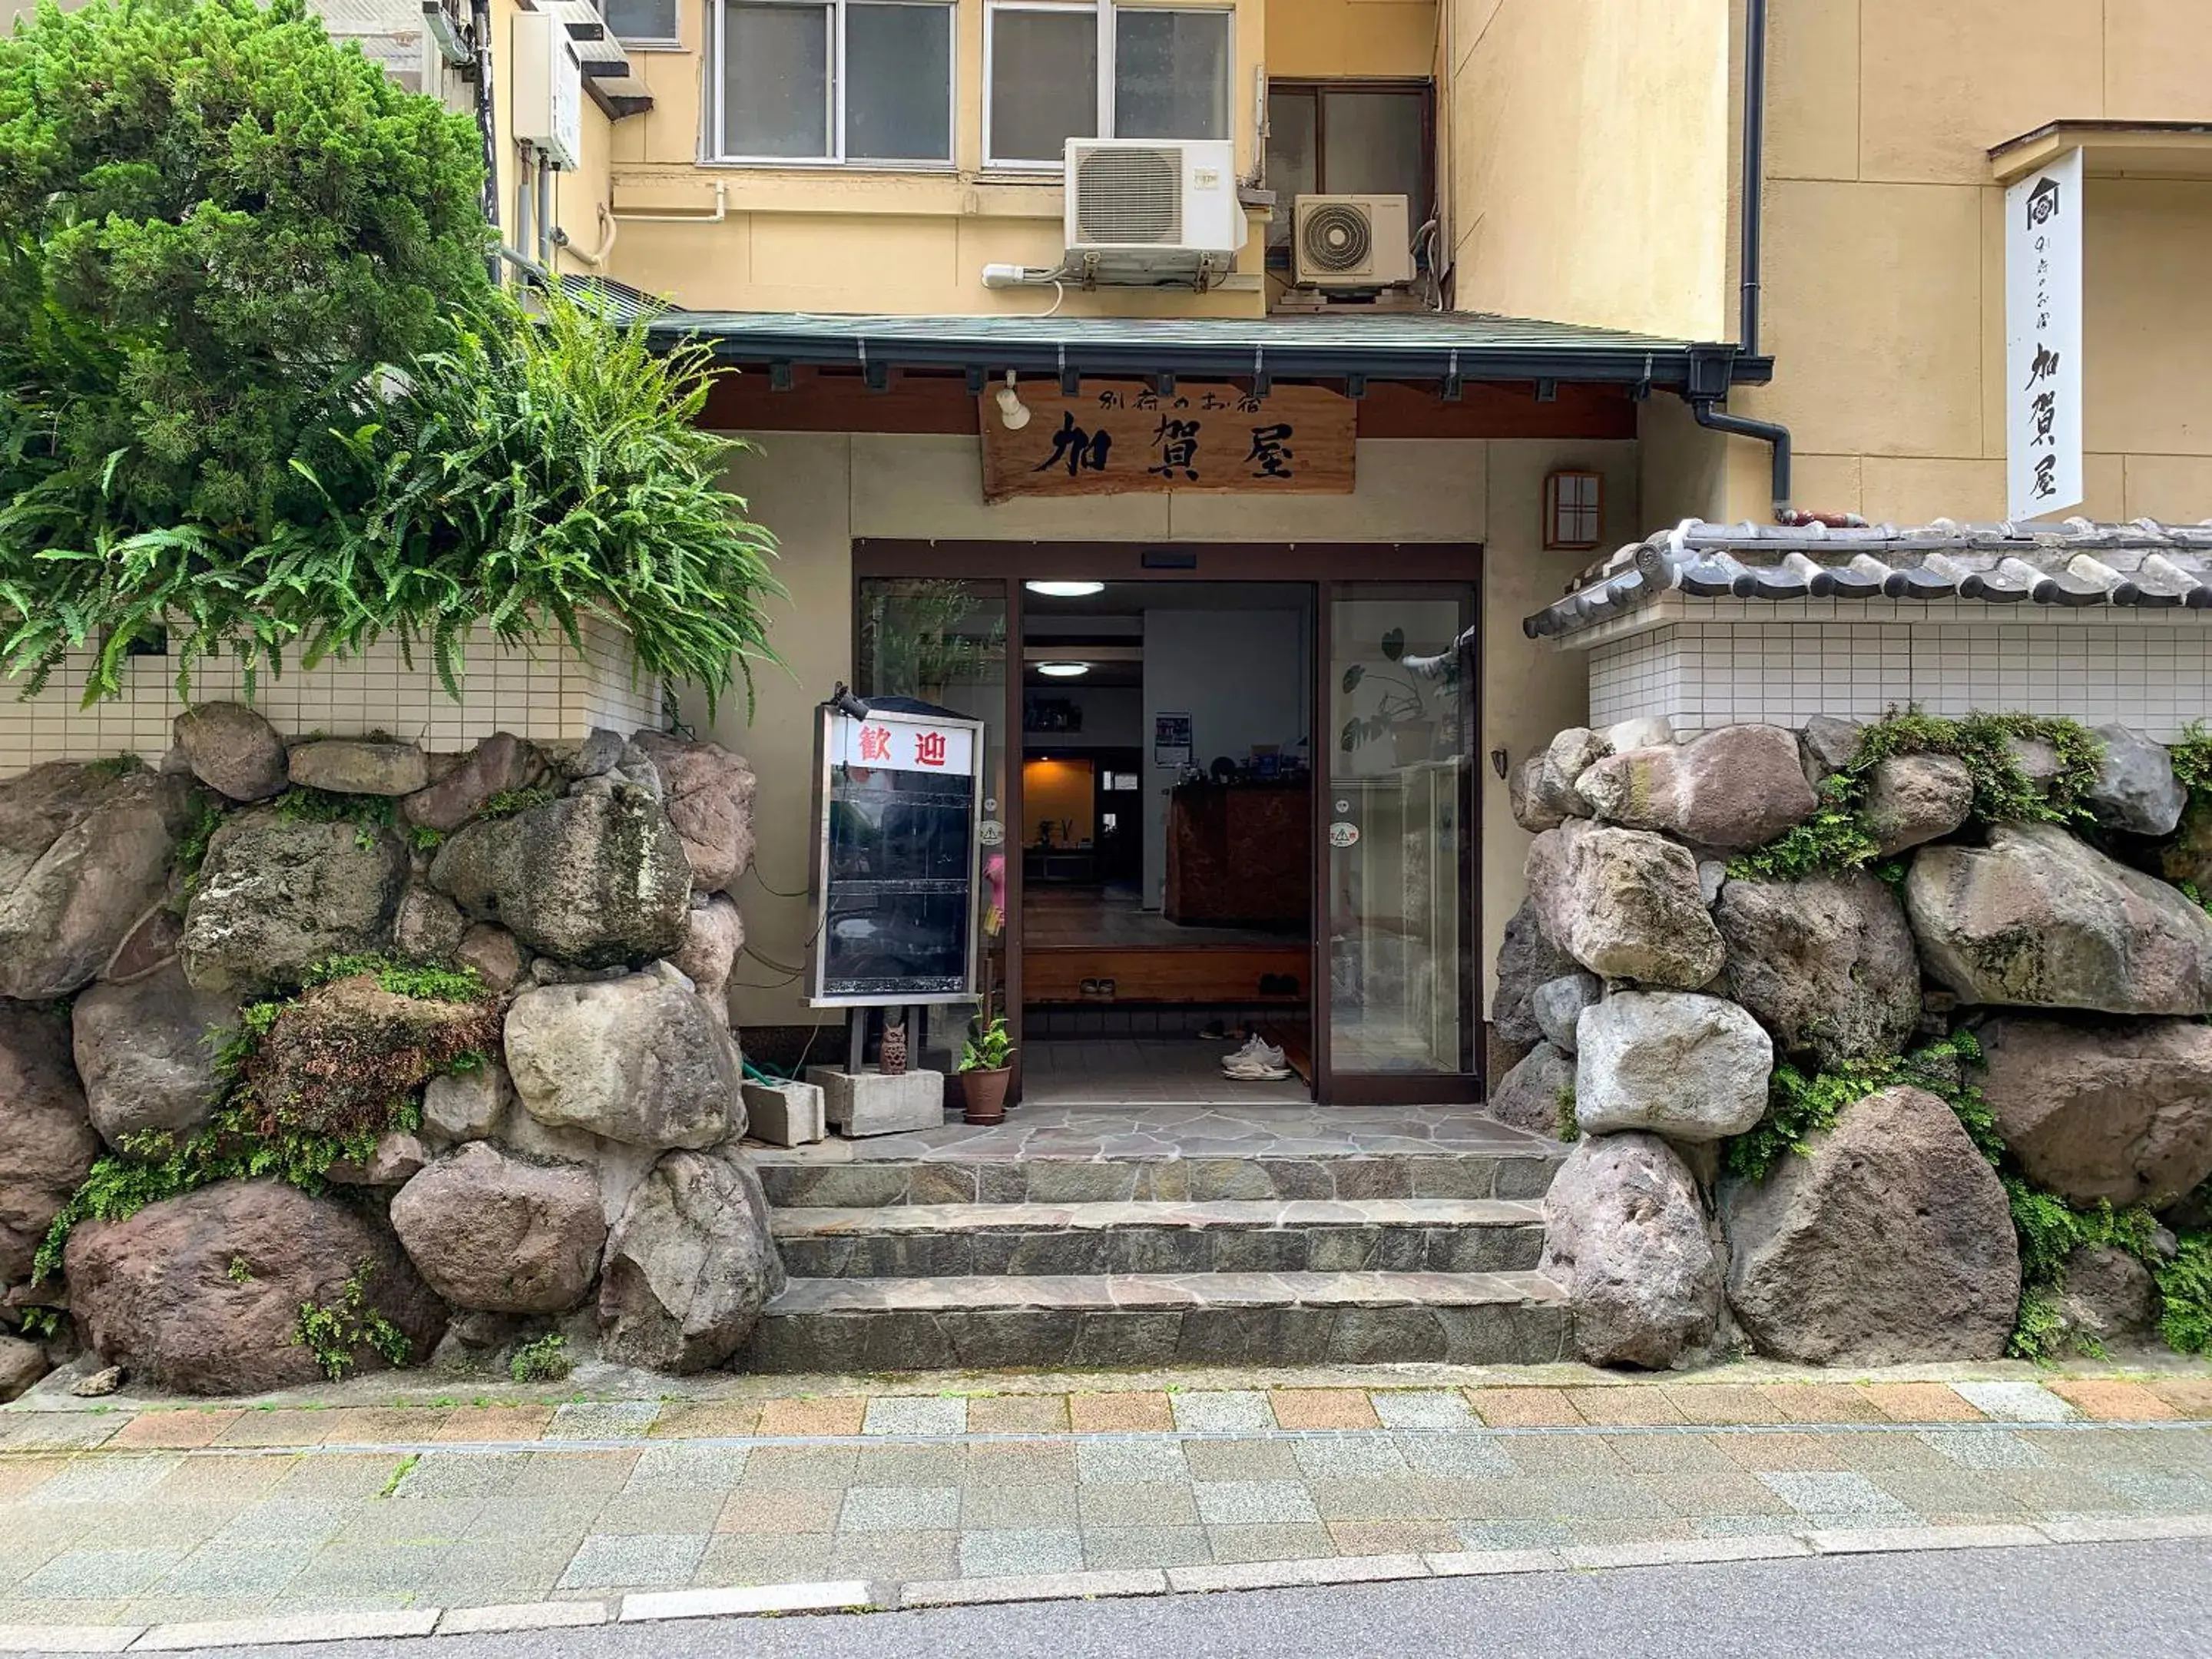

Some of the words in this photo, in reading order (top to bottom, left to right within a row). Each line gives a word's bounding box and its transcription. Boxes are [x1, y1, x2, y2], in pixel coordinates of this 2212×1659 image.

[1031, 410, 1294, 482] 加賀屋
[2025, 343, 2059, 502] 加賀屋
[858, 724, 946, 767] 歓迎
